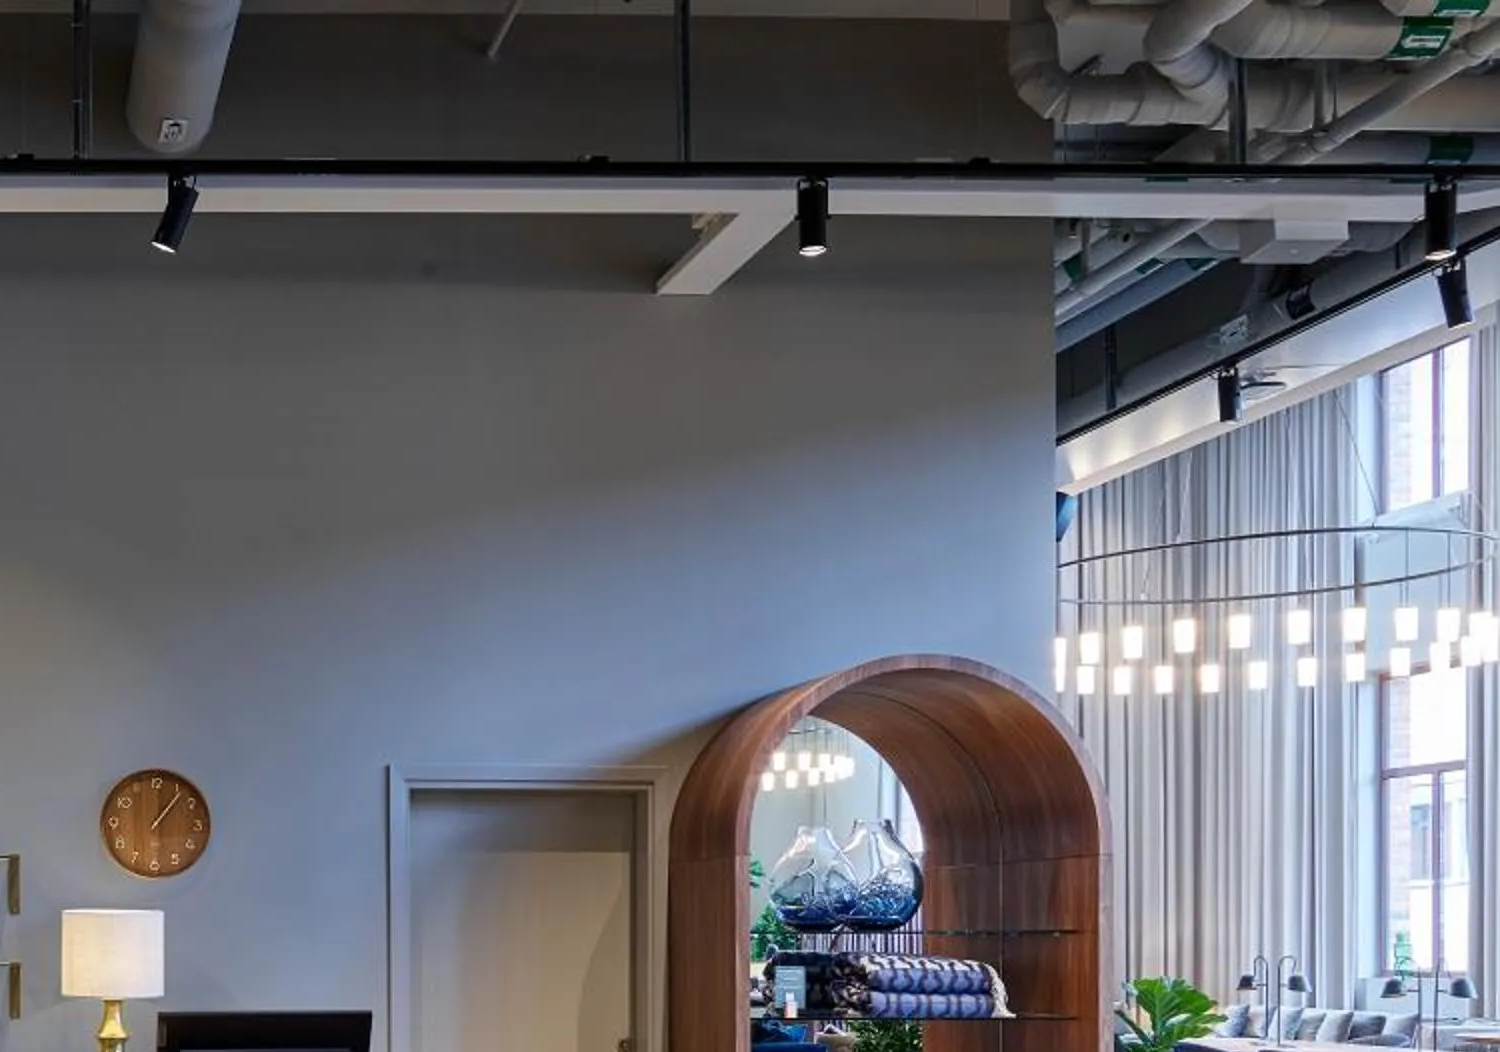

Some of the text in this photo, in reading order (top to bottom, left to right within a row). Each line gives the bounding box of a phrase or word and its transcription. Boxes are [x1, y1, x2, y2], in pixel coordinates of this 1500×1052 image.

[151, 778, 163, 789] 12
[117, 797, 132, 809] 10
[108, 816, 119, 830] 9
[193, 820, 203, 831] 3
[131, 850, 139, 863] 7
[171, 853, 180, 865] 5
[149, 860, 161, 871] 6
